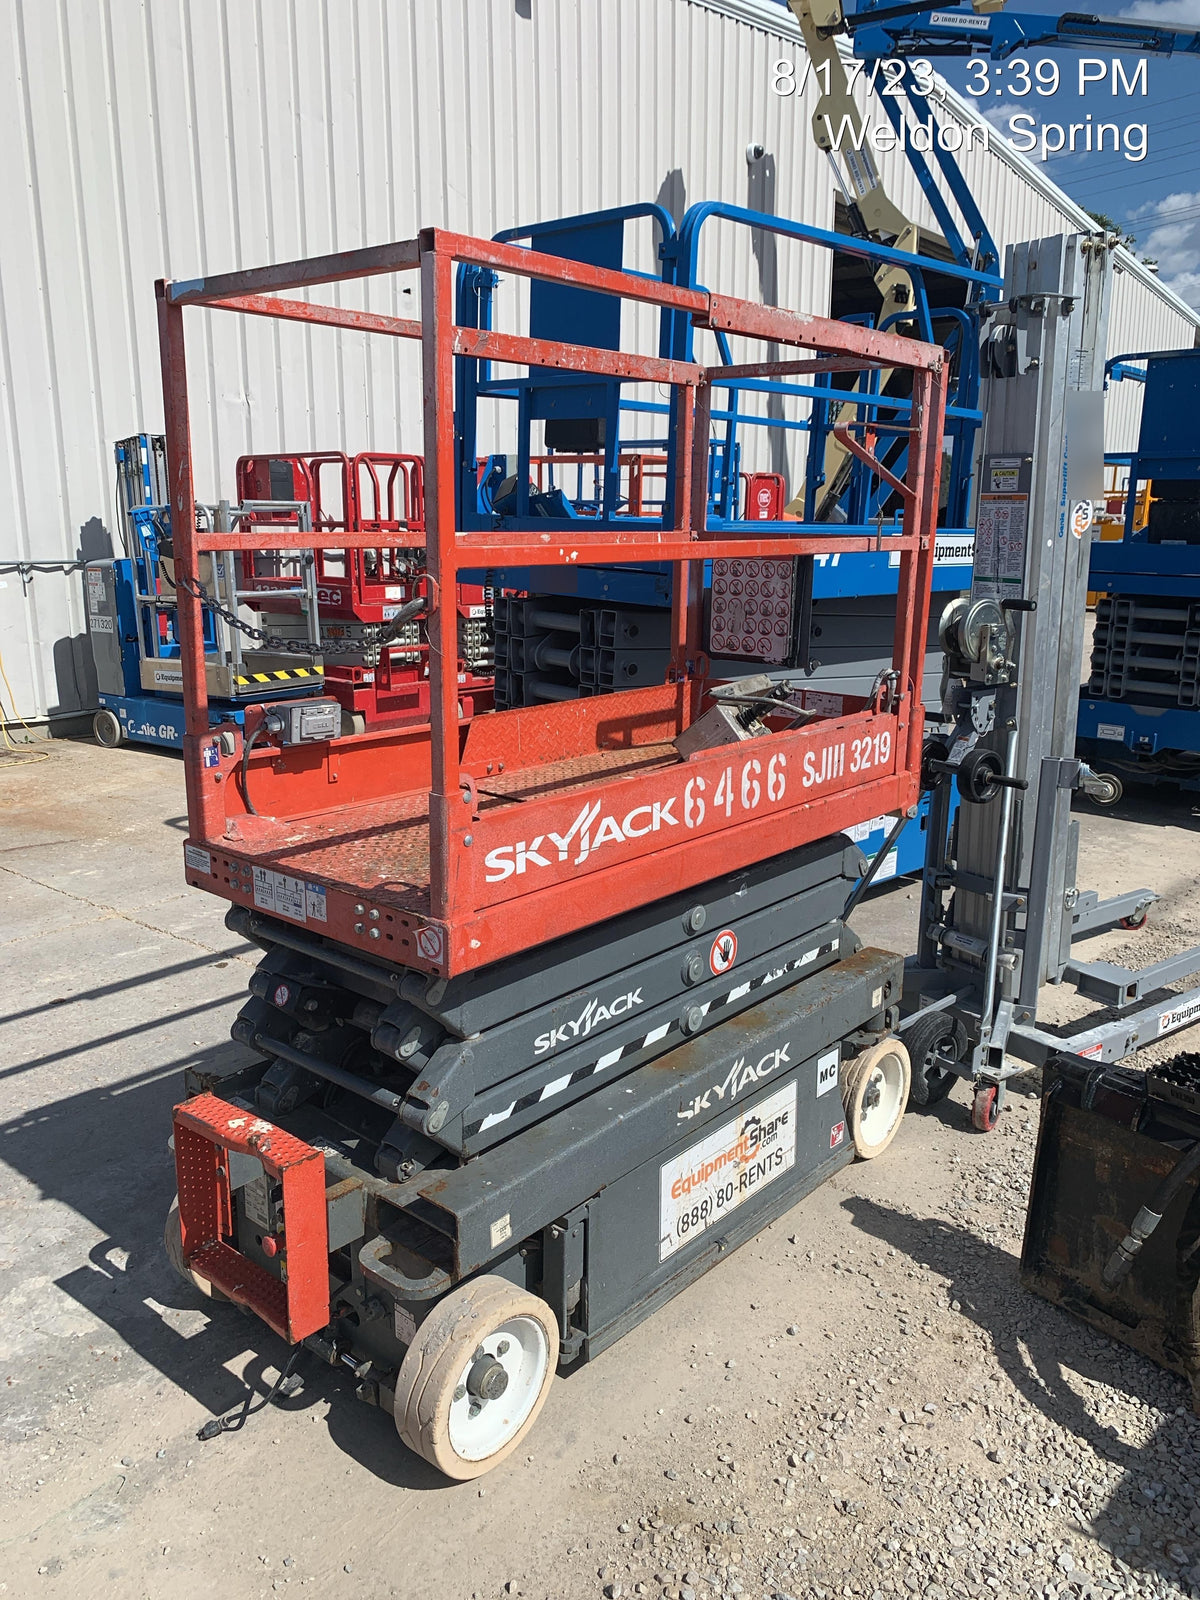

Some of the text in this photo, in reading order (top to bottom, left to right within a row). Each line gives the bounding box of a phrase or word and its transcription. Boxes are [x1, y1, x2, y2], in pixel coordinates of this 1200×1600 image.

[485, 731, 891, 882] SKYJACK 6466 SJIII 3219
[534, 987, 644, 1055] SKYJACK
[677, 1042, 791, 1126] SKYJACK
[819, 1064, 836, 1084] MC
[671, 1111, 789, 1200] EquipmentShare
[676, 1147, 783, 1238] (888) 80-RENTS
